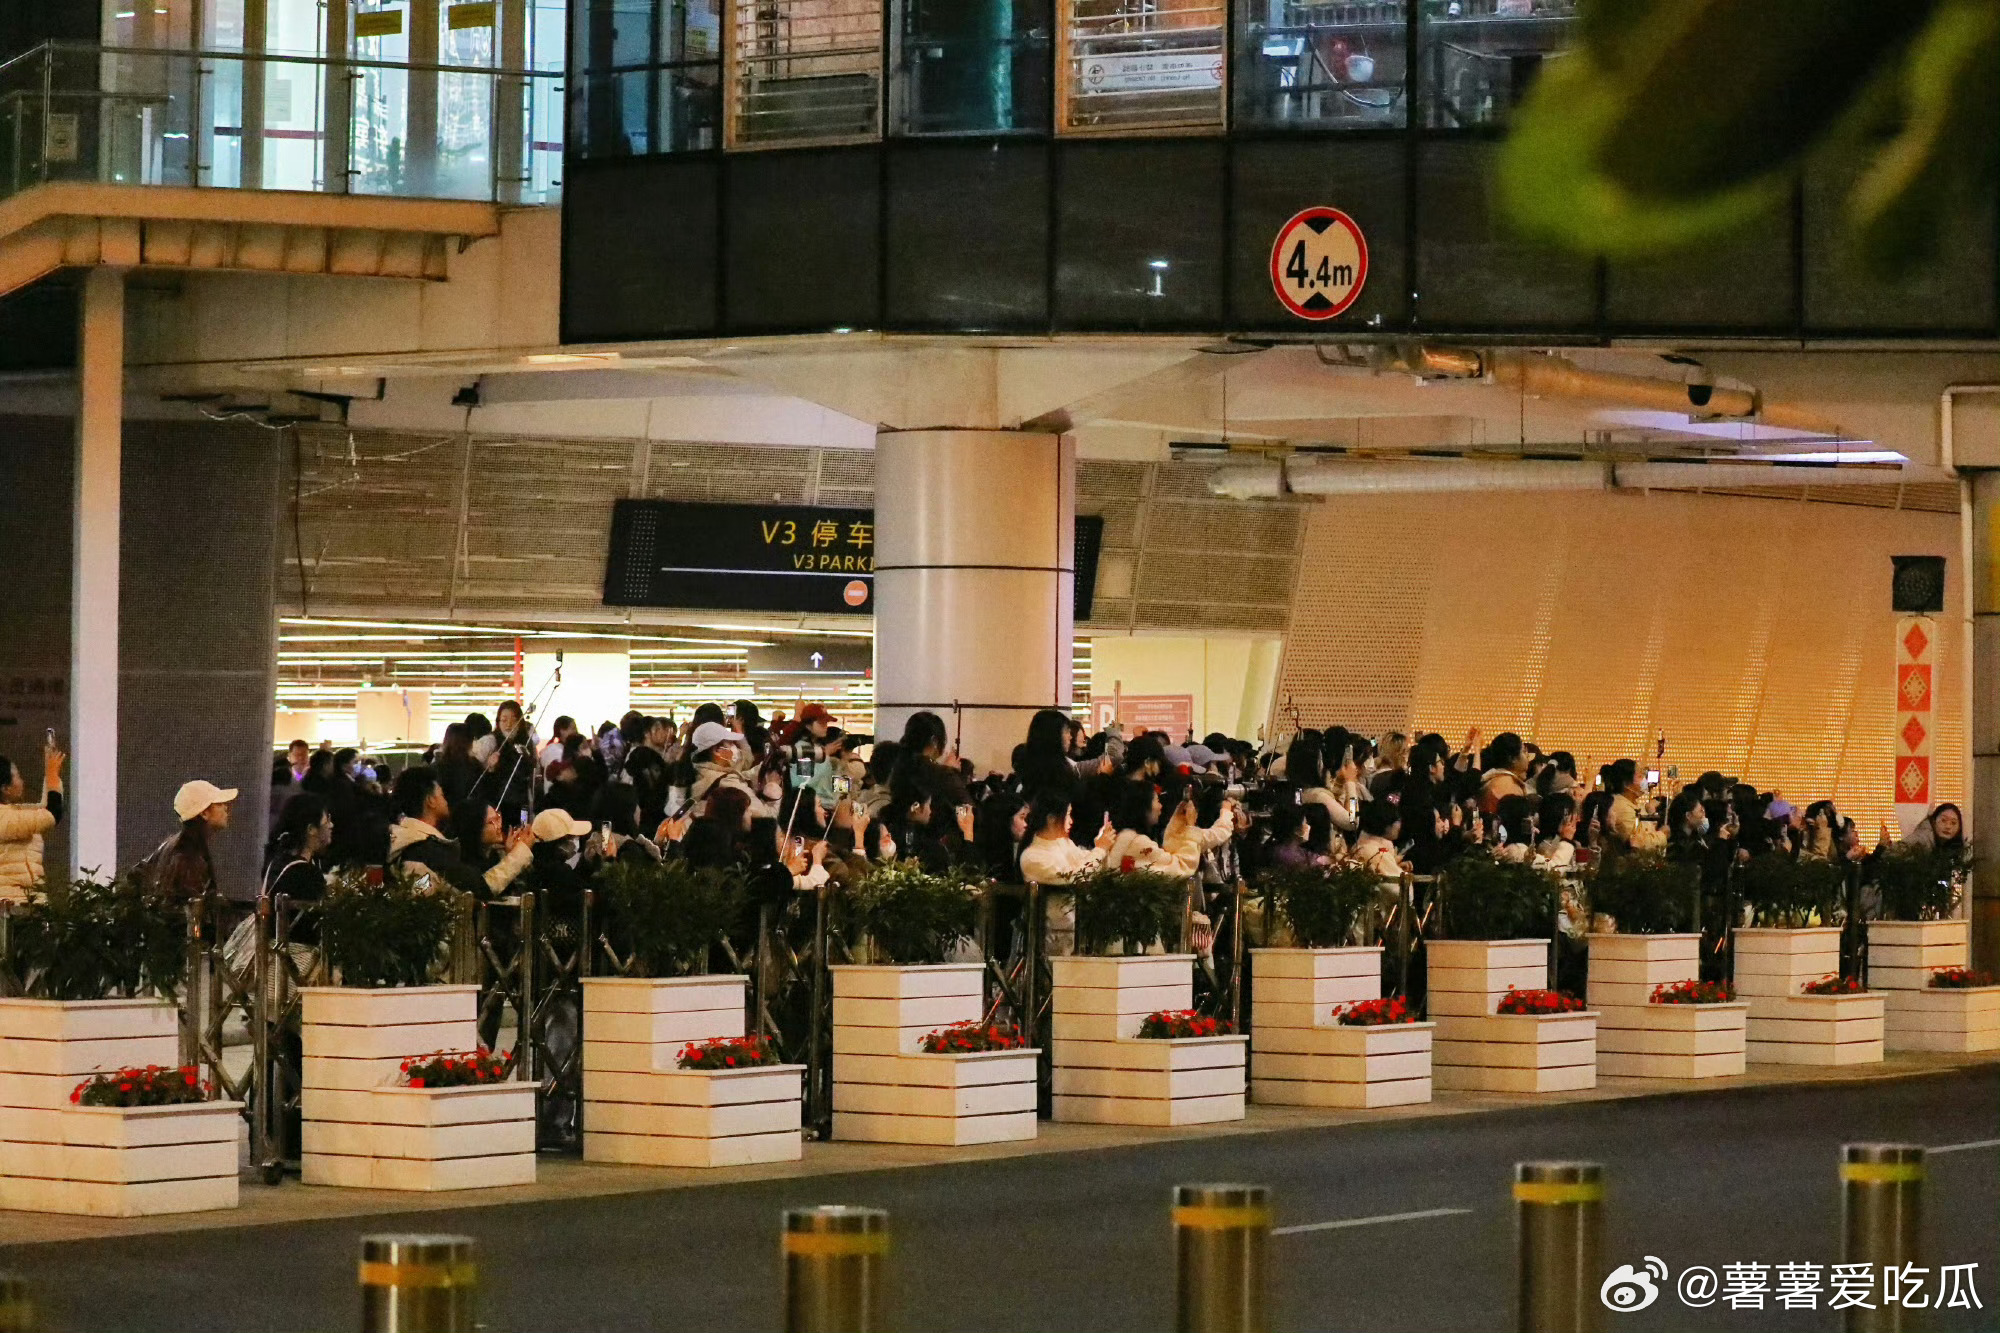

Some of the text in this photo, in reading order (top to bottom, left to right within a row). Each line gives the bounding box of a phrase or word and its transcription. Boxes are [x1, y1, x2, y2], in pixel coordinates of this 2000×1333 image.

[1286, 240, 1352, 289] 4.4m
[762, 520, 873, 549] V3 停车
[794, 554, 814, 569] V3
